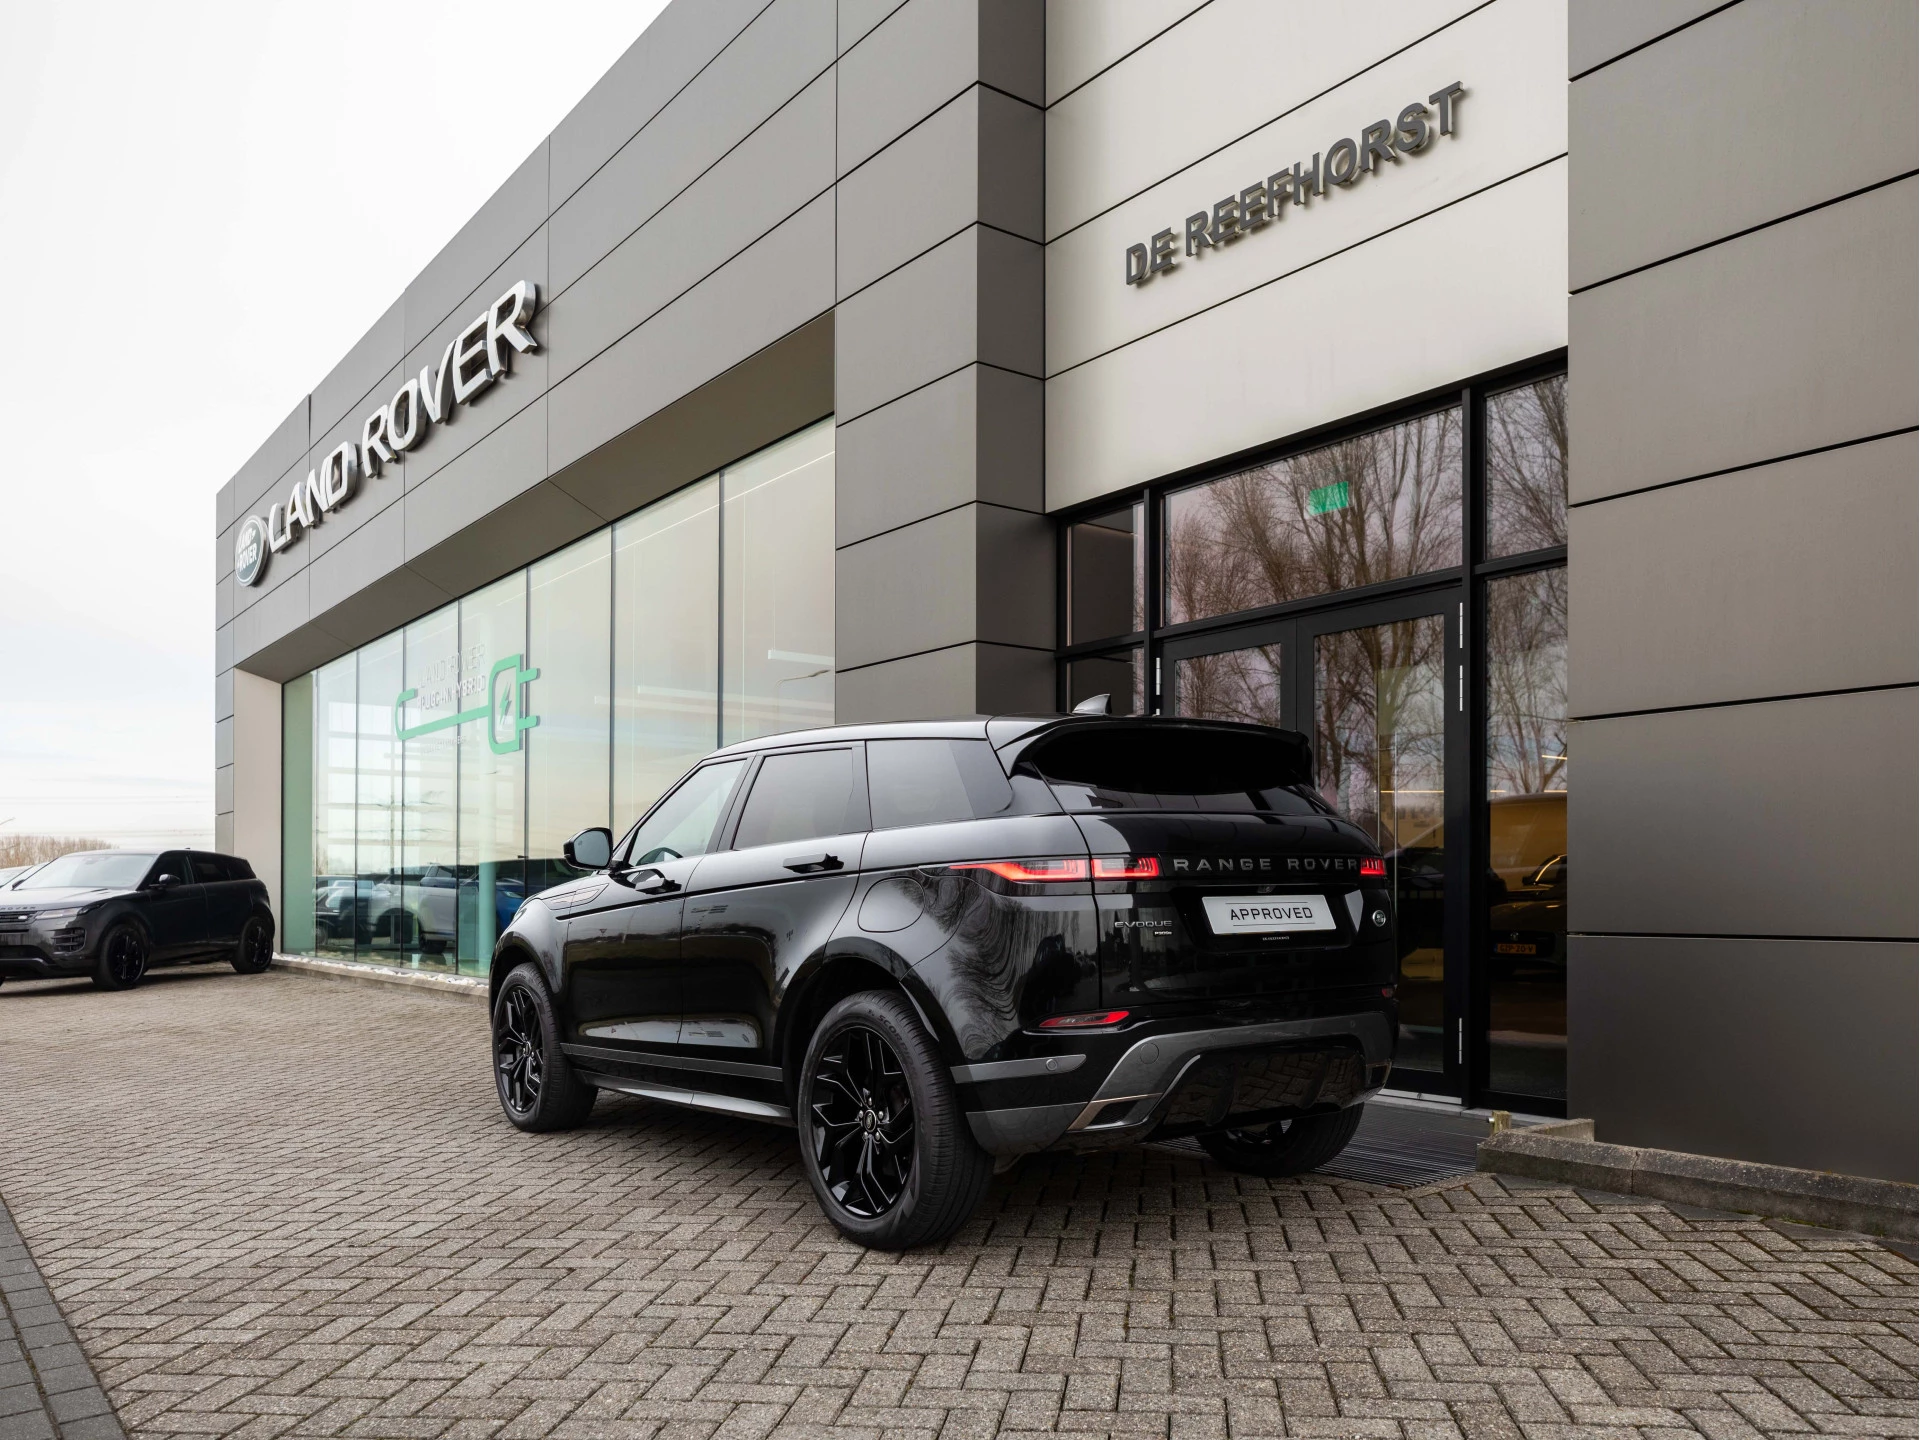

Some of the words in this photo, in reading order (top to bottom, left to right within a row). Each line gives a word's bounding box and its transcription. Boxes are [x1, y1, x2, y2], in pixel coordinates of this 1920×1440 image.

[1126, 227, 1176, 285] DE
[1186, 81, 1464, 257] REEFHORST
[268, 441, 356, 553] LAND
[362, 280, 538, 478] ROVER
[239, 543, 257, 572] ROVER
[1173, 858, 1272, 871] RANGE
[1287, 858, 1358, 871] ROVER
[1114, 920, 1173, 928] EVOQUE
[1230, 906, 1313, 922] APPROVED
